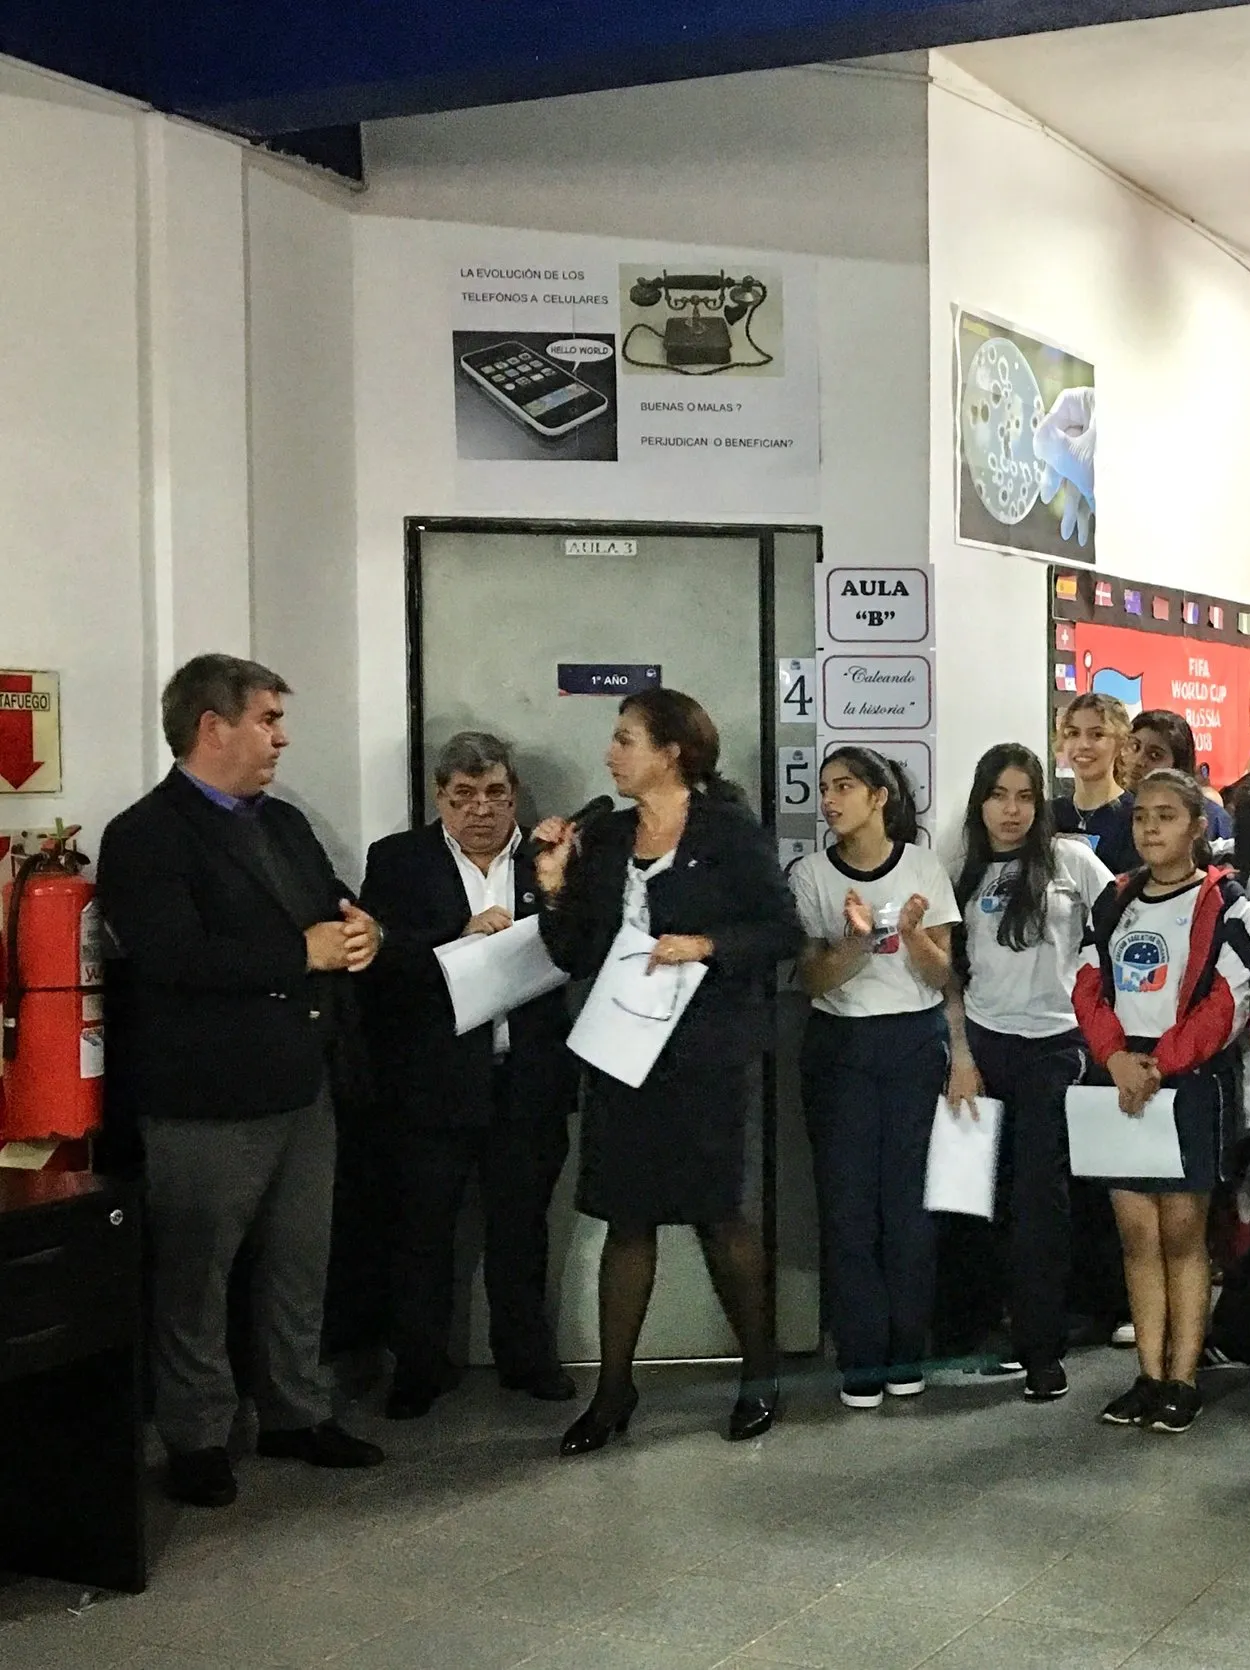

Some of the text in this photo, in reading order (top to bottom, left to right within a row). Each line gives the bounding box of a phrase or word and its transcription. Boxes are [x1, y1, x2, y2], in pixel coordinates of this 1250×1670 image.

[460, 268, 585, 281] LA EVOLUCIÓN DE LOS
[530, 294, 538, 303] A
[543, 294, 609, 305] CELULARES
[551, 345, 609, 356] HELLO WORLD
[640, 402, 684, 412] BUENAS
[686, 402, 696, 412] O
[697, 402, 733, 413] MALAS
[640, 435, 794, 448] PERJUDICAN O BENEFICIAN?
[569, 542, 633, 553] AULA 3
[840, 579, 910, 597] AULA
[1188, 657, 1211, 678] FIFA
[604, 674, 628, 685] AÑO
[783, 675, 813, 716] 4
[1171, 680, 1227, 704] WORLD CUP
[843, 701, 856, 715] la
[1185, 707, 1221, 728] RUSSIA
[1193, 732, 1212, 752] 018
[785, 762, 810, 805] 5
